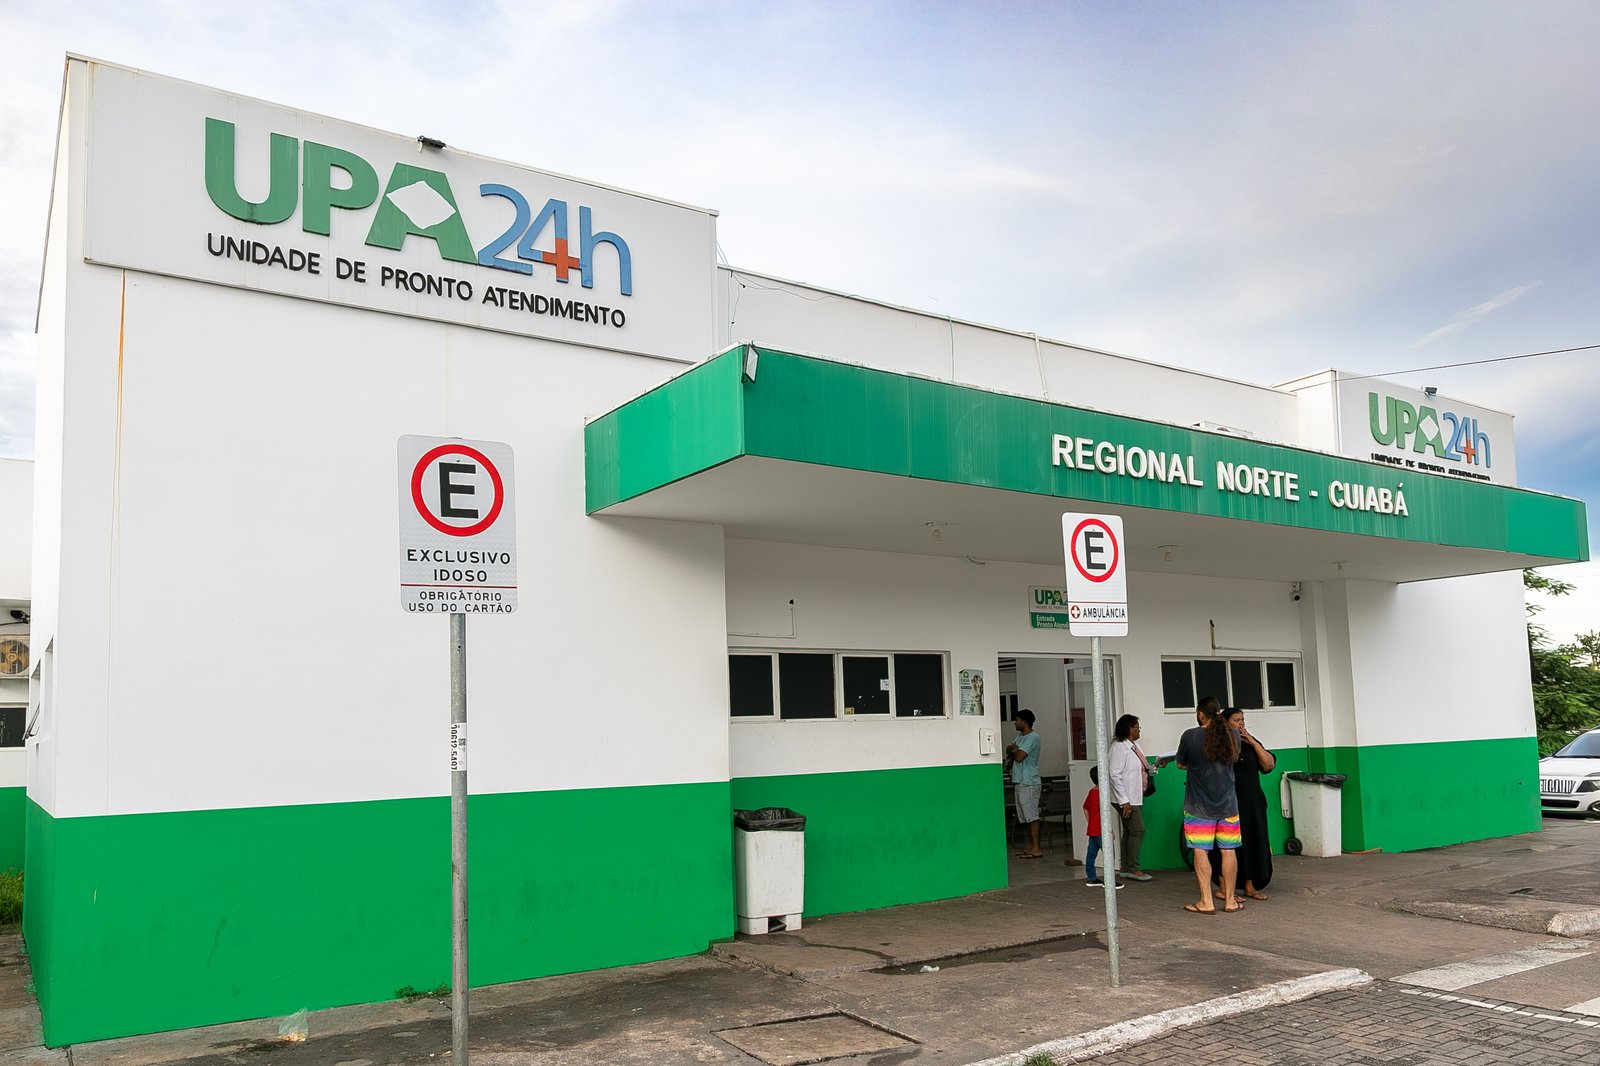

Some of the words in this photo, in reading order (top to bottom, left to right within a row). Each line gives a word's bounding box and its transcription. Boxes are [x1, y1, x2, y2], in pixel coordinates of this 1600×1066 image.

[207, 232, 321, 275] UNIDADE
[335, 257, 366, 284] DE
[381, 266, 473, 301] PRONTO
[482, 286, 627, 328] ATENDIMENTO
[1052, 434, 1204, 487] REGIONAL
[1217, 461, 1300, 502] NORTE
[1328, 480, 1410, 516] CUIABÁ
[438, 462, 479, 519] E
[407, 549, 511, 565] EXCLUSIVO
[1084, 531, 1107, 570] E
[433, 569, 488, 583] IDOSO
[408, 603, 434, 612] USO
[441, 603, 458, 613] DO
[464, 602, 513, 613] CARTÃO
[1083, 605, 1126, 619] AMBULÂNCIA
[1036, 614, 1056, 622] Entrada
